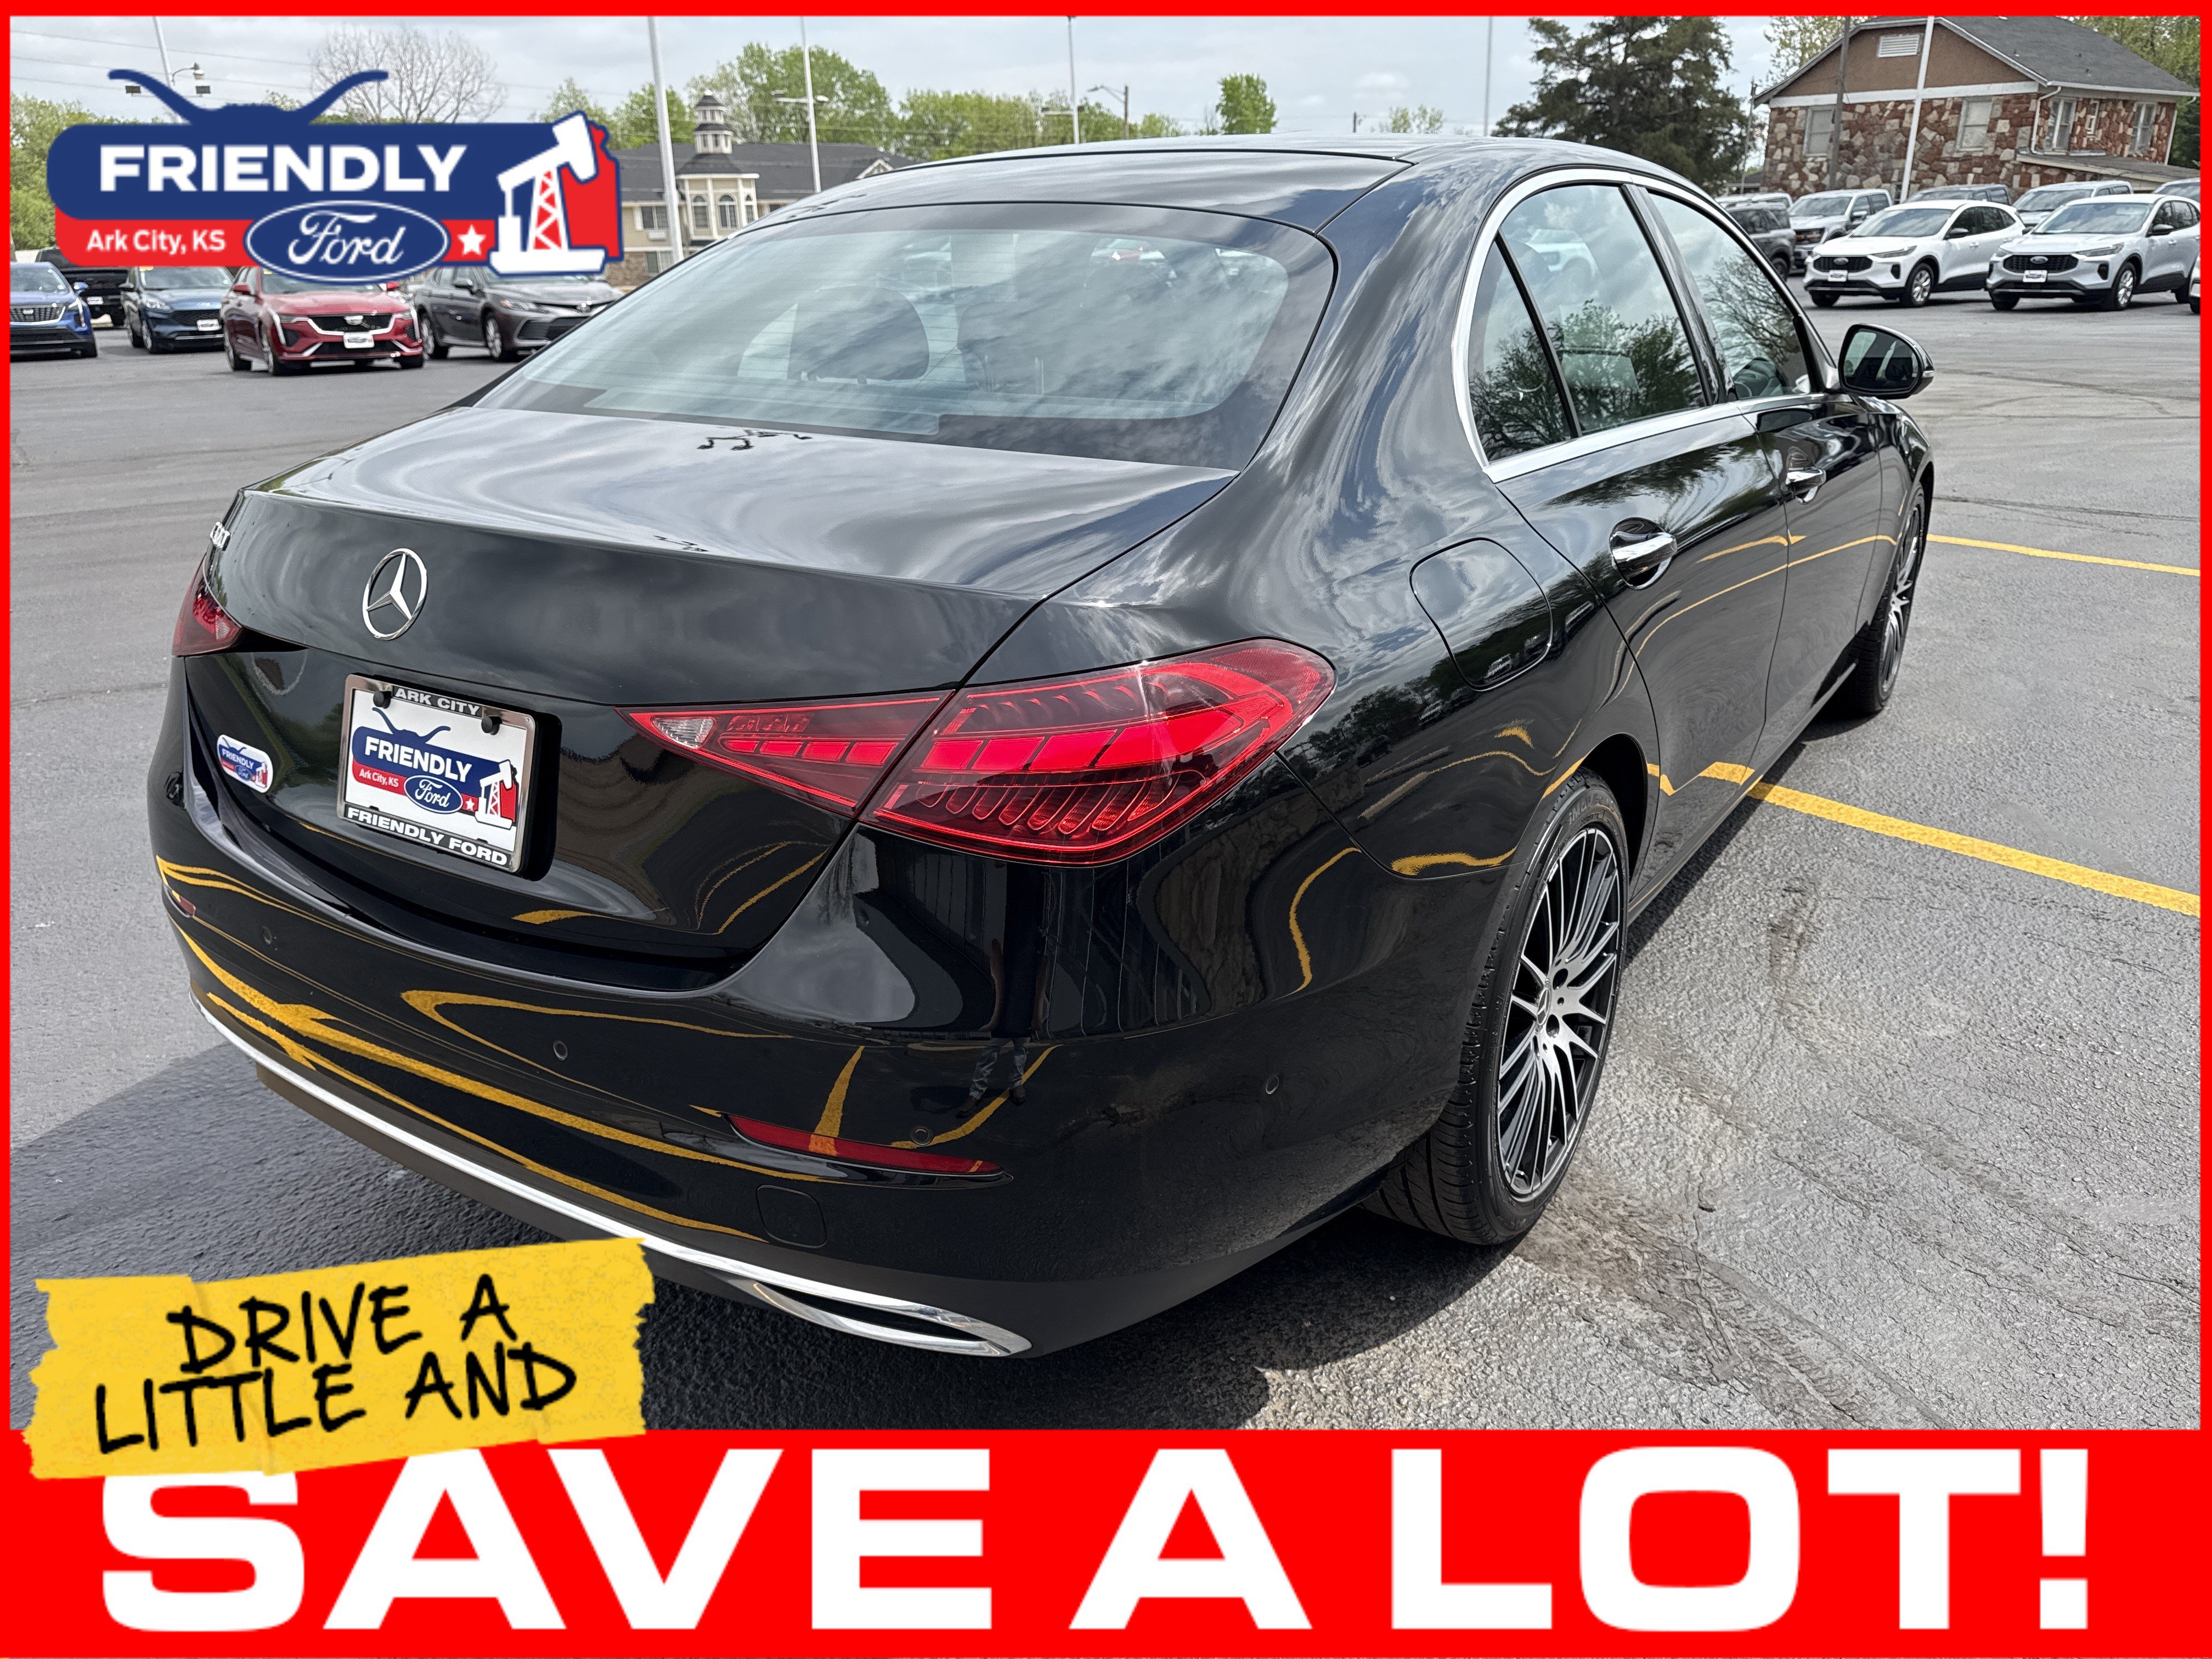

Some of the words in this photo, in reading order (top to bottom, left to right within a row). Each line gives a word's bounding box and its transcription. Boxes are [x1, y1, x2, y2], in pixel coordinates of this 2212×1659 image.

[394, 688, 432, 706] ARK
[437, 697, 480, 715] CITY
[221, 748, 254, 770] FRIENDLY
[364, 736, 472, 783] FRIENDLY
[359, 768, 371, 780] Ark
[372, 771, 388, 787] City,
[388, 776, 399, 788] KS
[415, 778, 449, 808] Ford
[347, 806, 445, 845] FRIENDLY
[448, 837, 507, 866] FORD
